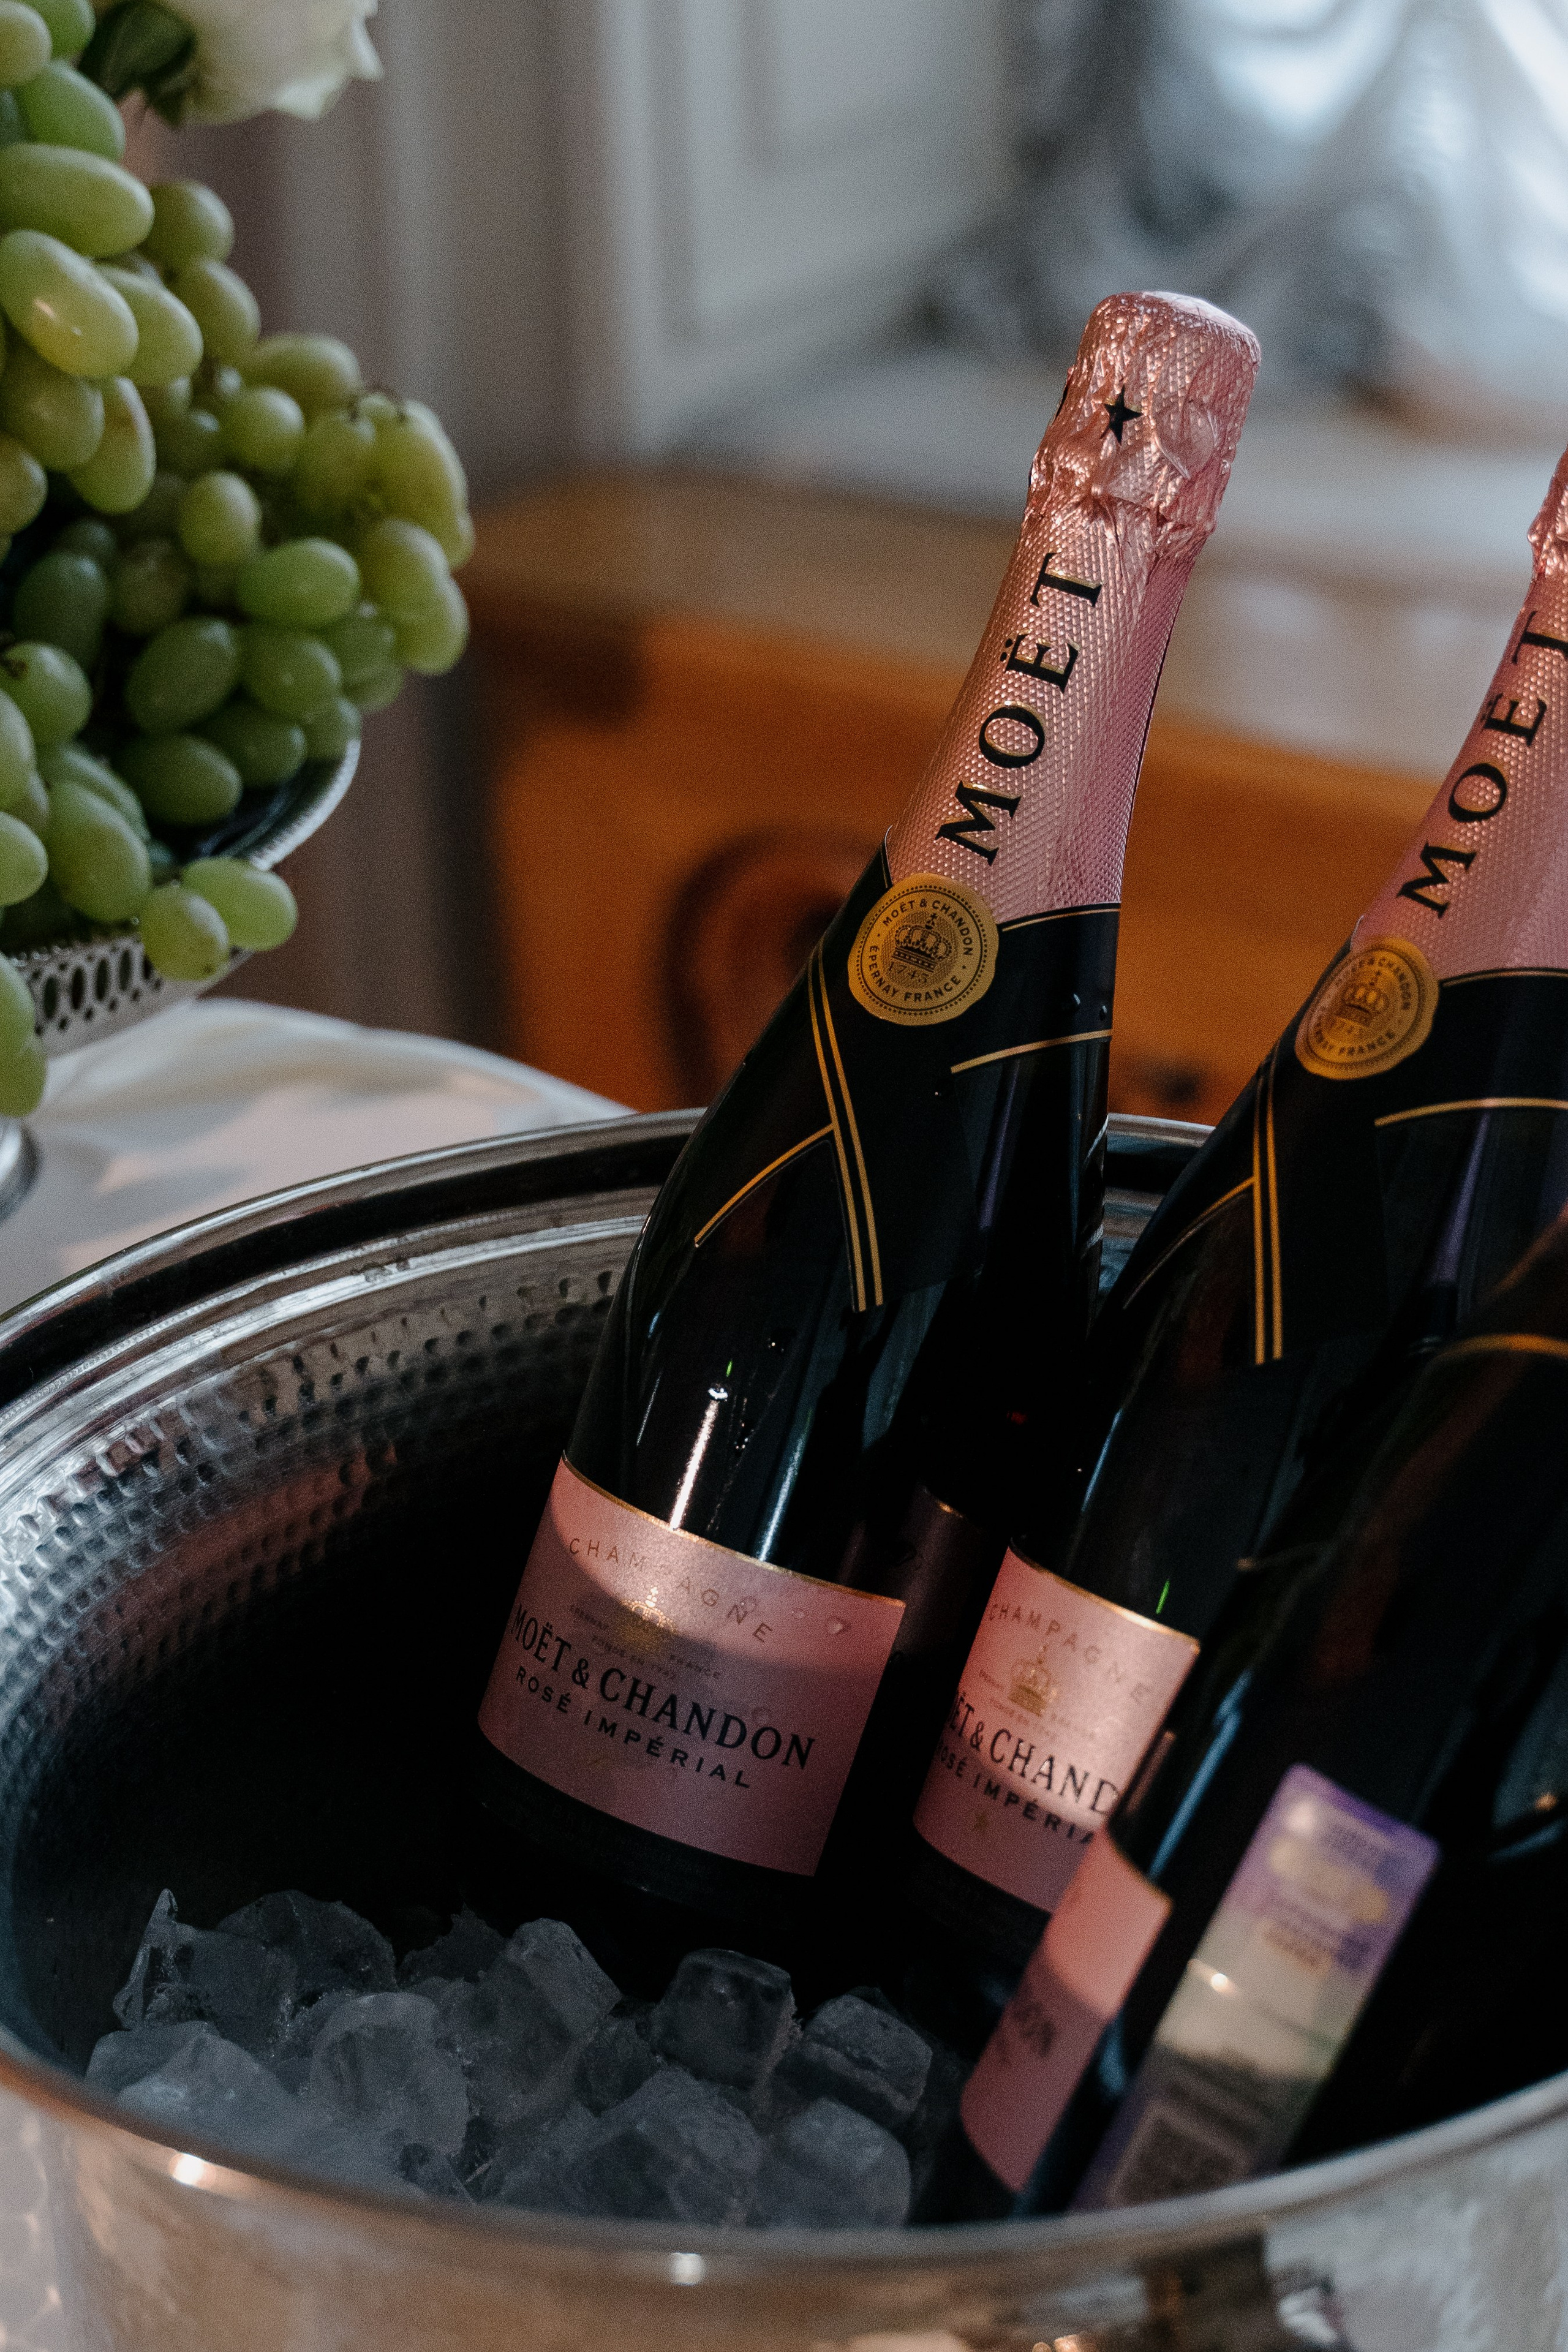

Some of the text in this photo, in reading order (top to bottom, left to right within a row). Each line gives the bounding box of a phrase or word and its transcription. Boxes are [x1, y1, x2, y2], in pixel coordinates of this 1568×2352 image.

[934, 552, 1103, 866] MOËT
[869, 945, 961, 1002] ÉPERNAY FRANCE
[883, 899, 973, 956] MOËT & CHANDON
[570, 1538, 773, 1643] CHAMAGNE
[510, 1604, 815, 1770] MOËT & CHANDON
[987, 1602, 1152, 1706] CHAMPAGNE
[516, 1666, 750, 1789] ROSÉ IMPÉRIAL
[970, 1721, 984, 1751] &
[989, 1728, 1118, 1815] CHAND
